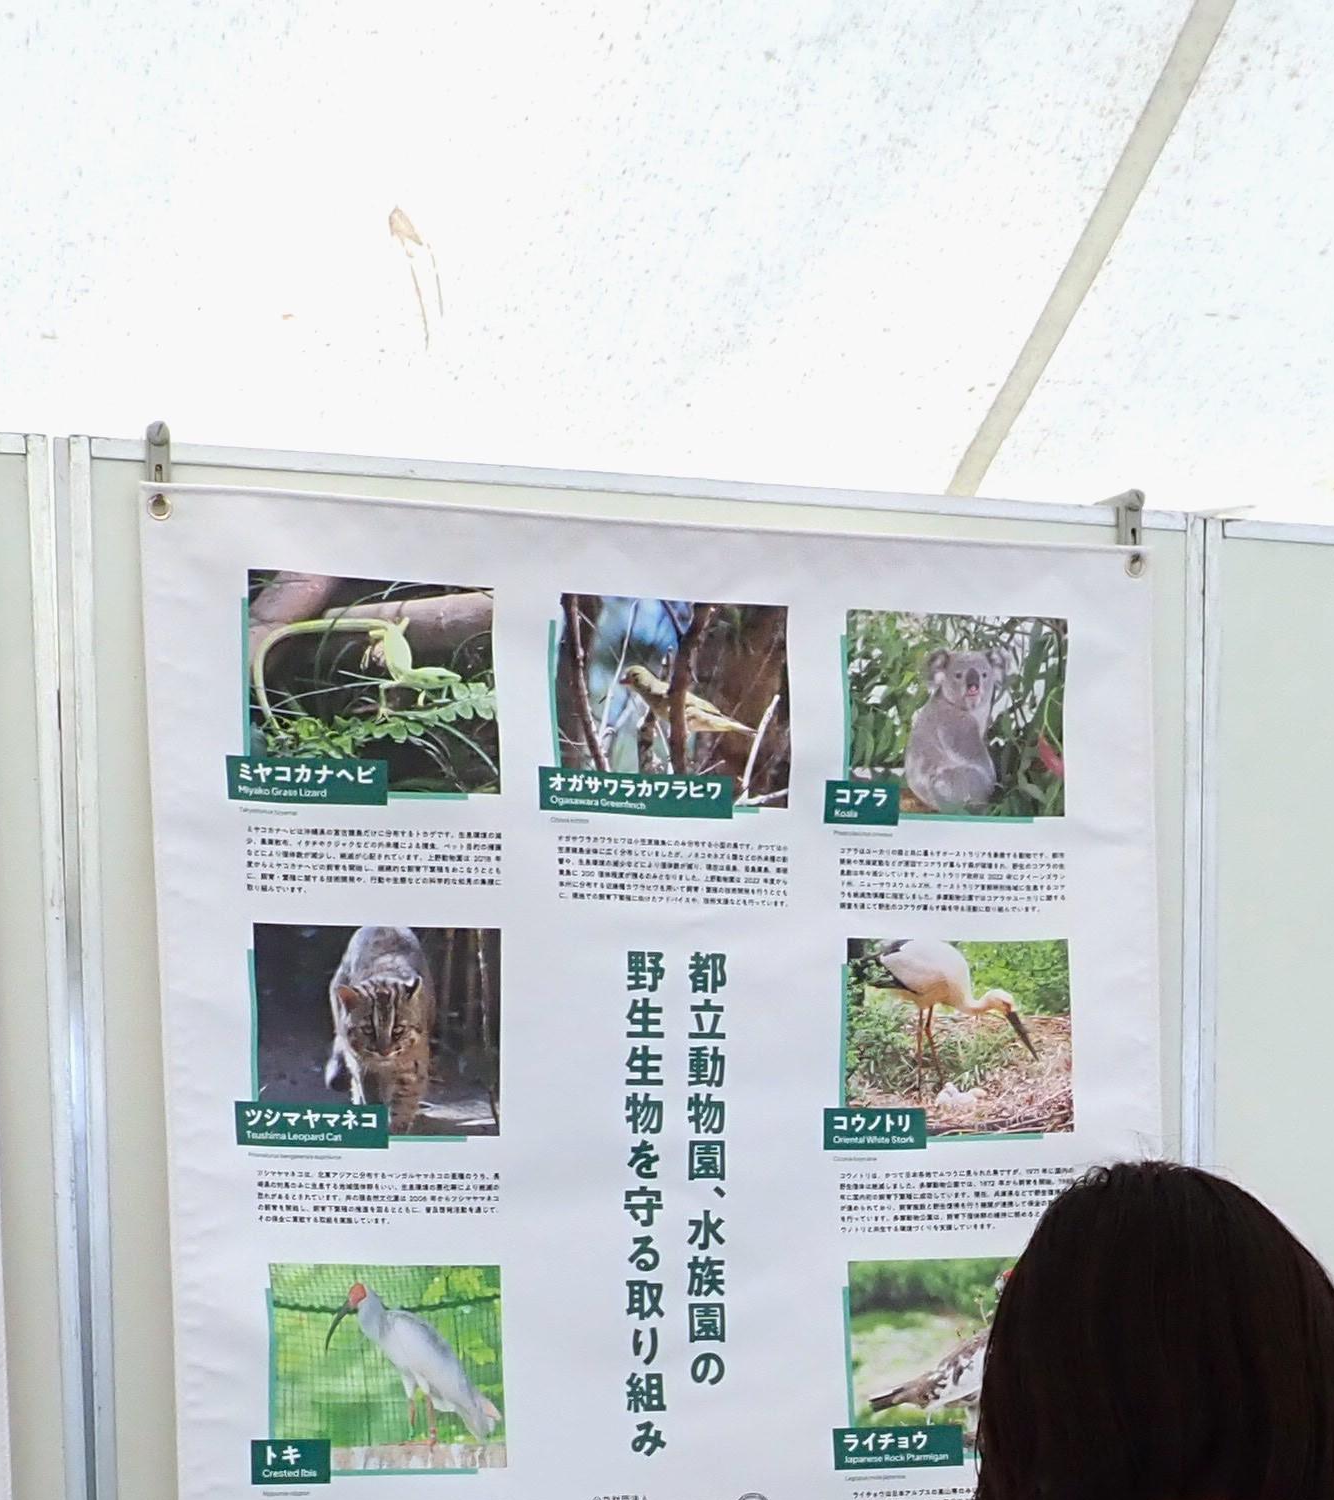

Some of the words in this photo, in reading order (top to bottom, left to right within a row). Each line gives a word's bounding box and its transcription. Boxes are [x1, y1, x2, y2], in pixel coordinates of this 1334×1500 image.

[237, 762, 375, 788] ミヤコカナヘビ
[237, 784, 269, 798] Miyako
[298, 787, 327, 799] Lizard
[547, 773, 723, 802] オガサワラカワラヒワ
[834, 787, 889, 808] コアラ
[834, 808, 859, 819] Koala
[244, 1108, 378, 1130] ツシマヤマネコ
[832, 1113, 911, 1133] コウノトリ
[245, 1130, 287, 1142] Tsushima
[287, 1131, 324, 1144] Leopard
[325, 1132, 343, 1143] Cat
[866, 1134, 891, 1144] White
[891, 1134, 915, 1144] Stork
[686, 952, 728, 1387] 都立動物園、水族園の
[623, 950, 668, 1458] 野生生物を守る取り組み
[842, 1431, 928, 1452] ライチョウ
[266, 1445, 302, 1466] トキ
[262, 1468, 300, 1478] Crested
